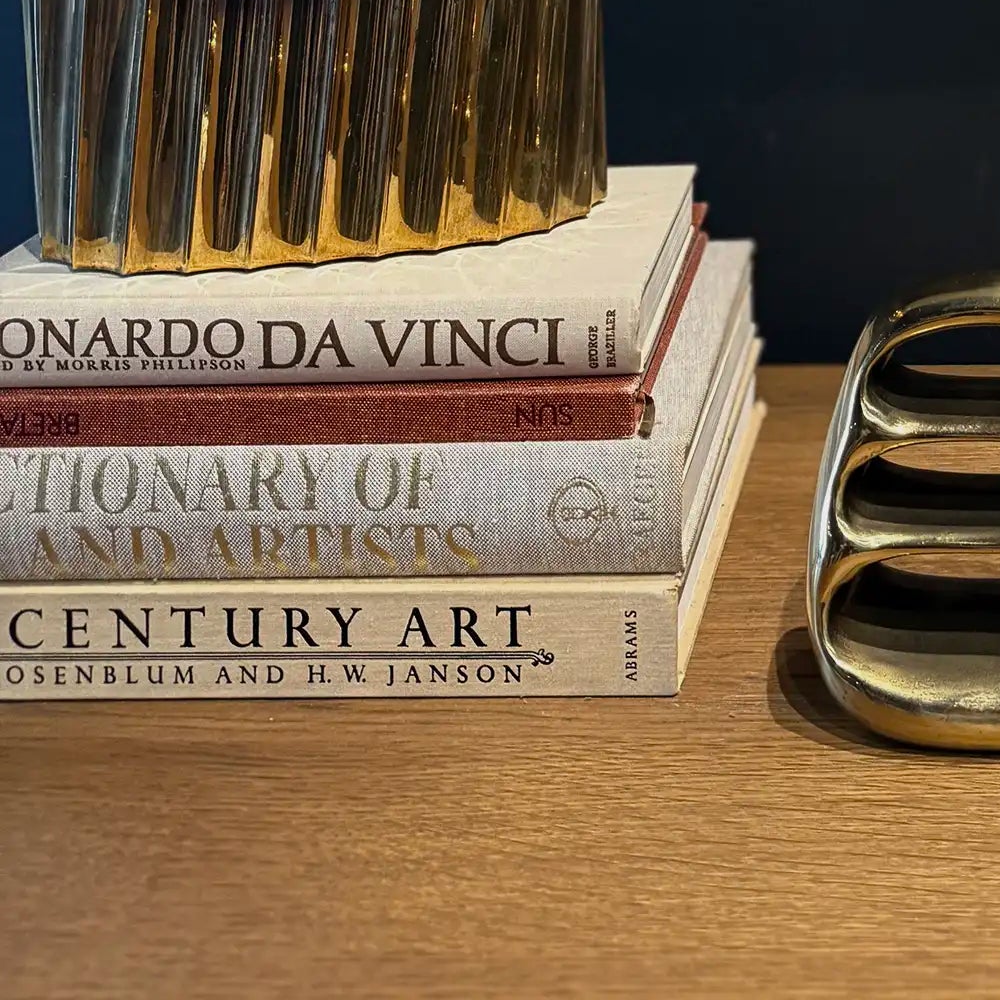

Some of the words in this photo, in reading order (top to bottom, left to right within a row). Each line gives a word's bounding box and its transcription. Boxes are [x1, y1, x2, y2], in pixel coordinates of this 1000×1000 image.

[0, 317, 245, 359] ONARDO
[256, 319, 356, 370] DA
[364, 317, 566, 368] VINCI
[587, 325, 599, 369] GEORGE
[605, 308, 617, 369] BRAZILLER
[23, 359, 46, 372] BY
[55, 359, 132, 372] MORRIS
[140, 358, 246, 371] PHILIPSON
[514, 402, 575, 429] SUN
[354, 449, 443, 512] OF
[28, 524, 180, 578] AND
[205, 522, 482, 576] ARTISTS
[8, 606, 363, 650] CENTURY
[397, 604, 532, 649] ART
[624, 609, 639, 683] ABRAMS
[5, 664, 195, 686] OSENBLUM
[215, 664, 285, 685] AND
[307, 664, 333, 685] H.
[342, 664, 368, 685] W.
[386, 663, 523, 687] JANSON
